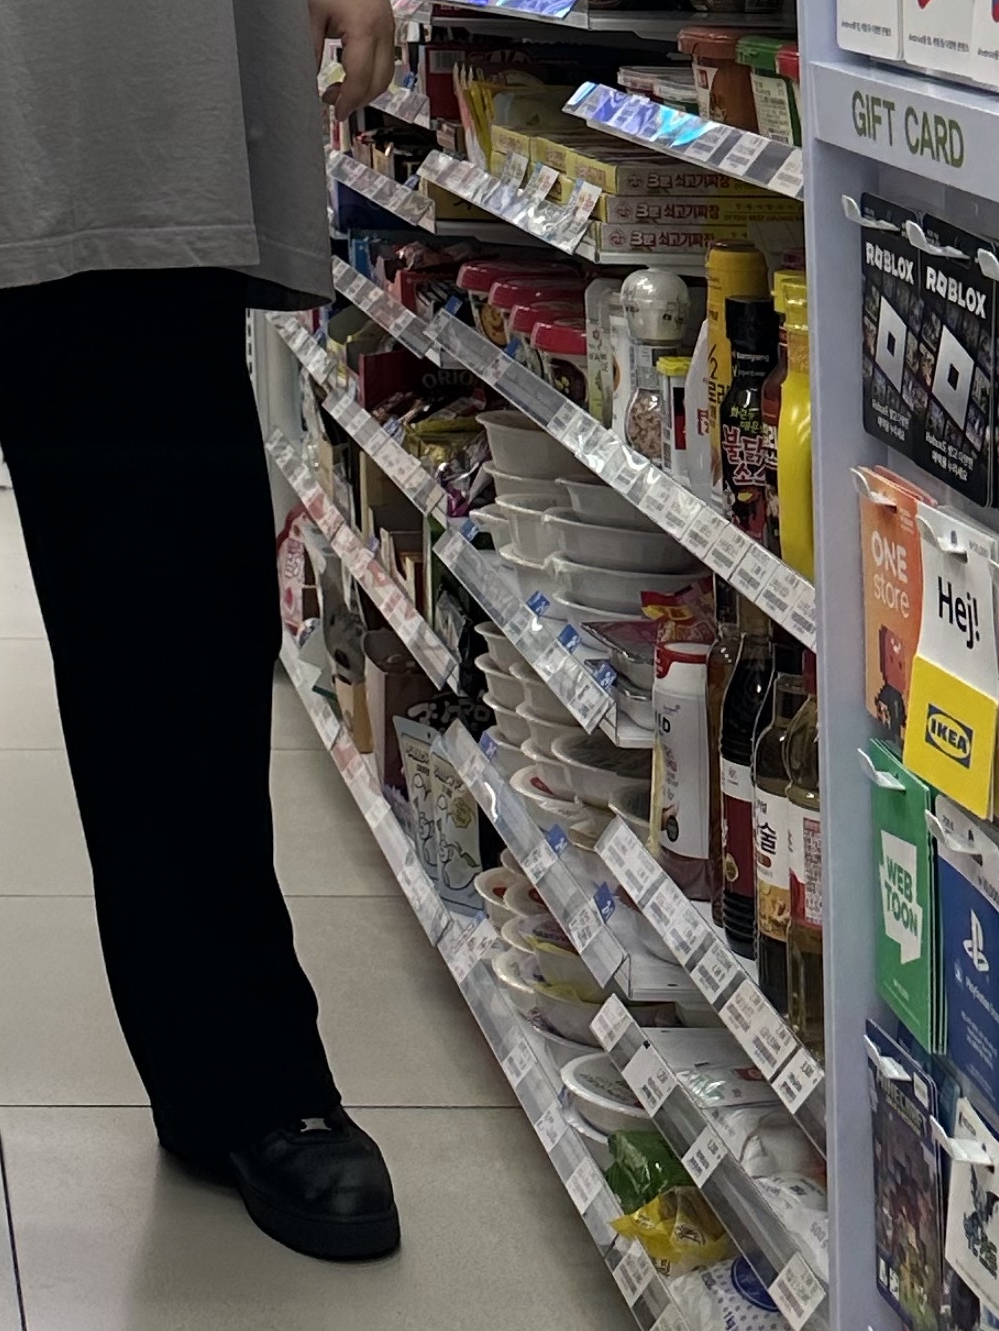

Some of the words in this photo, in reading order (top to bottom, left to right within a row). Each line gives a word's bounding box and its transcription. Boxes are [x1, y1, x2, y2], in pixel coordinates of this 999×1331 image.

[851, 89, 896, 147] GIFT
[904, 105, 965, 169] CARD
[647, 174, 673, 189] 3분
[675, 173, 731, 189] 쇠고기짜장
[636, 204, 662, 220] 3분
[664, 204, 720, 221] 쇠고기짜장
[630, 231, 656, 247] 3분
[865, 240, 915, 286] ROBLOX
[926, 265, 987, 320] ROBLOX
[871, 530, 908, 584] ONE
[873, 572, 910, 620] store
[938, 575, 981, 651] Hej!
[929, 717, 968, 755] IKEA
[886, 855, 913, 904] WEB
[884, 882, 918, 938] TOON
